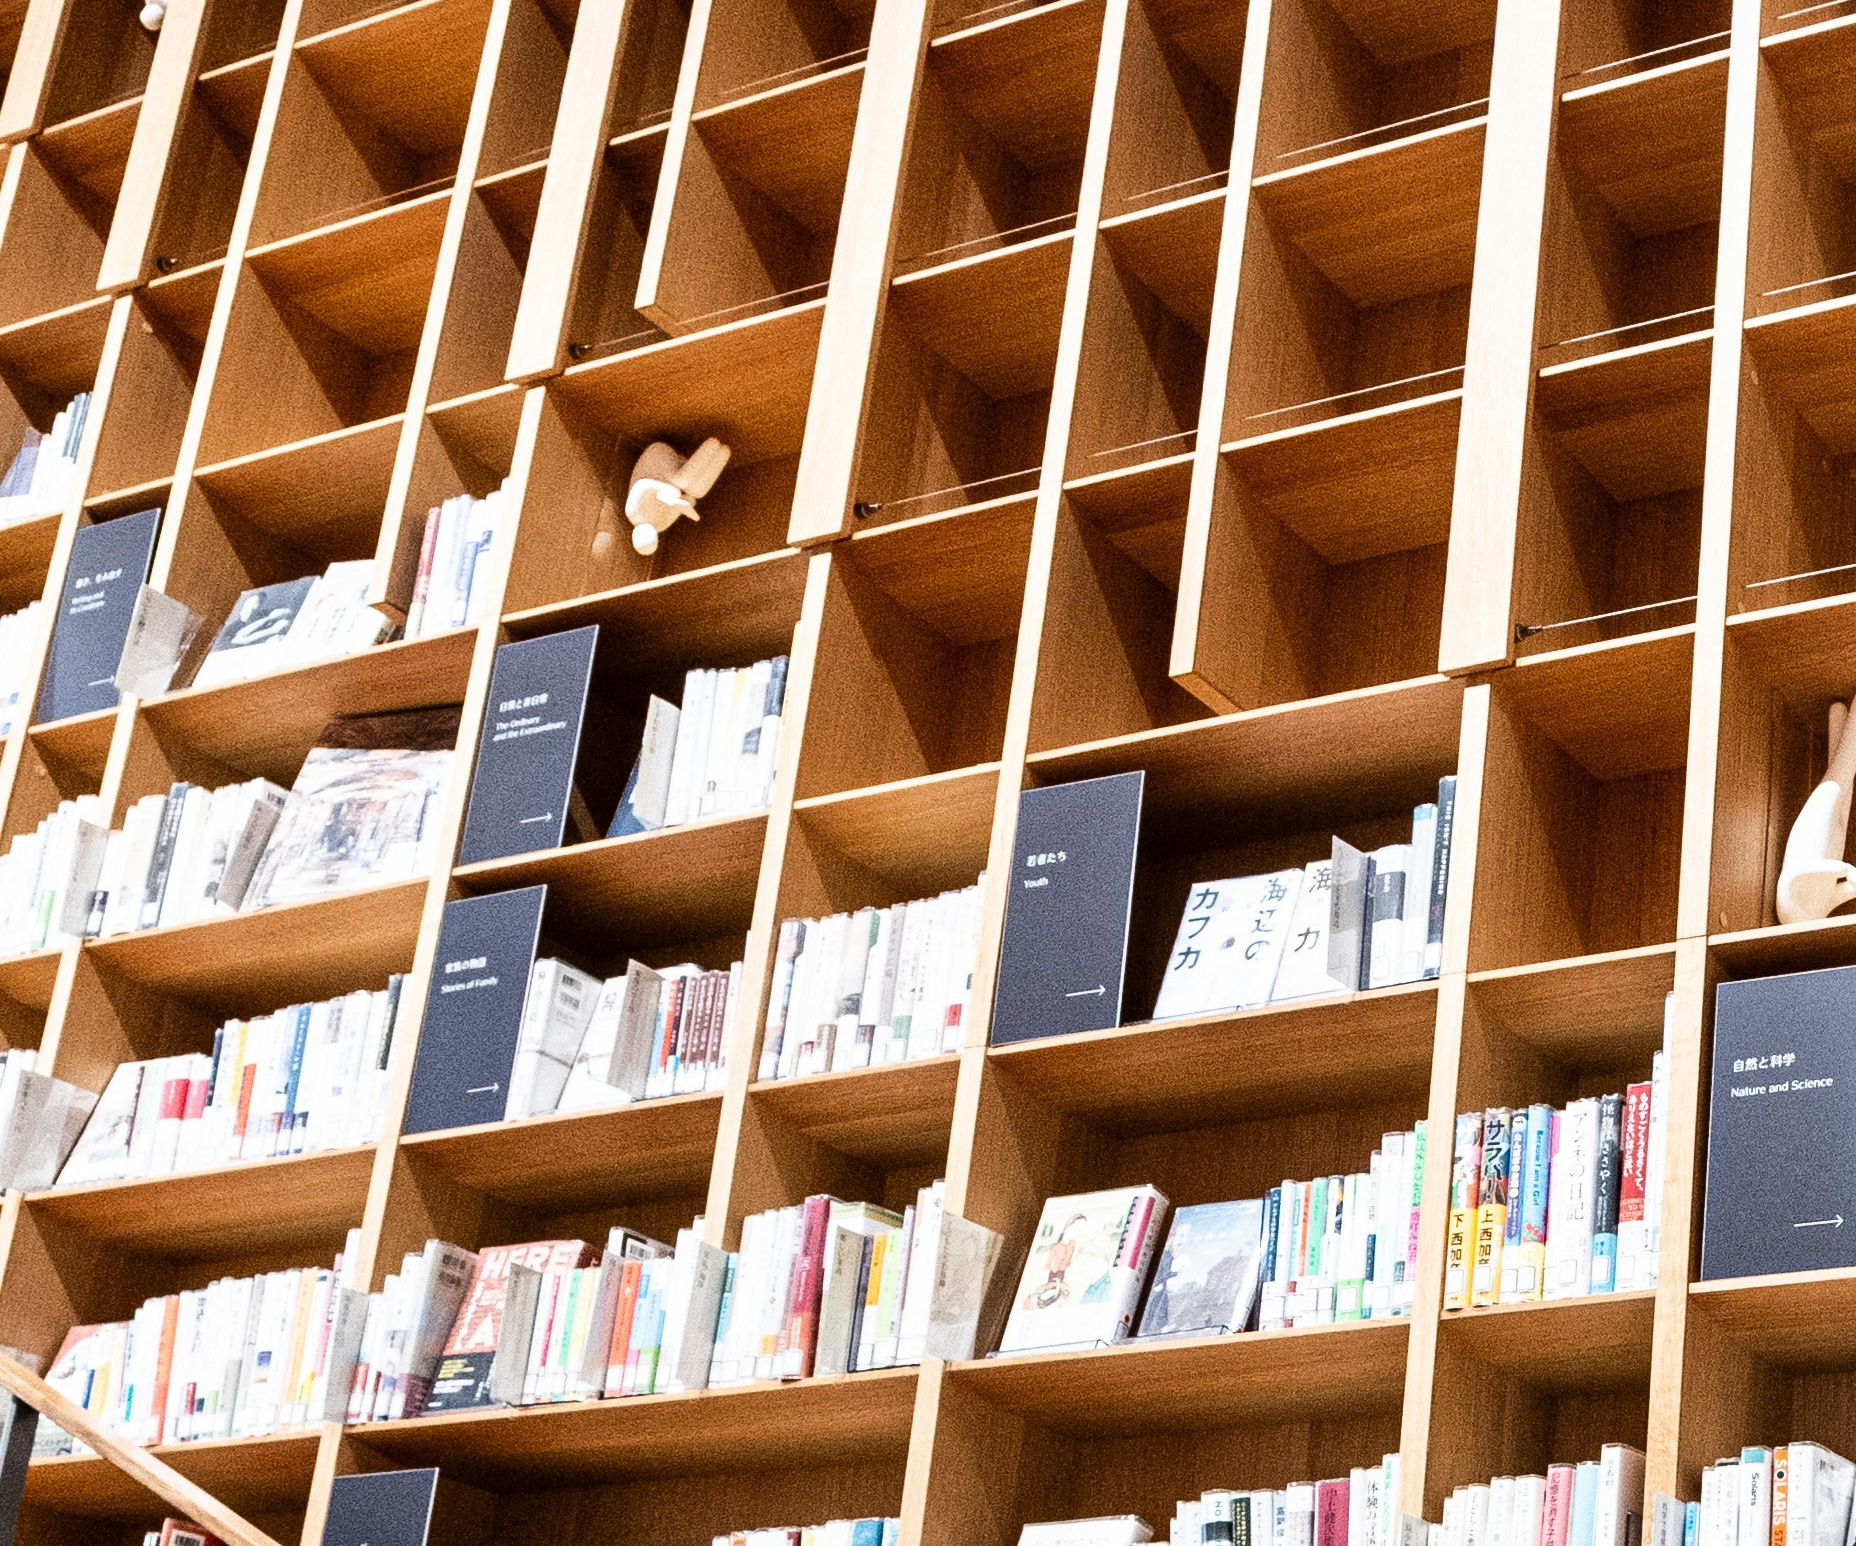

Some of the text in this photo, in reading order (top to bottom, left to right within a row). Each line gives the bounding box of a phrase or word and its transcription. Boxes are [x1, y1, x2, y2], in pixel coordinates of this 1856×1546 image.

[1024, 876, 1048, 888] Youth
[1174, 888, 1219, 971] カフカ
[1244, 879, 1288, 961] 海辺の
[1733, 1052, 1796, 1073] 自然と科学
[1731, 1076, 1834, 1098] Nature and Science
[1568, 1111, 1588, 1221] アンネの日記
[1750, 1472, 1760, 1507] Solaris
